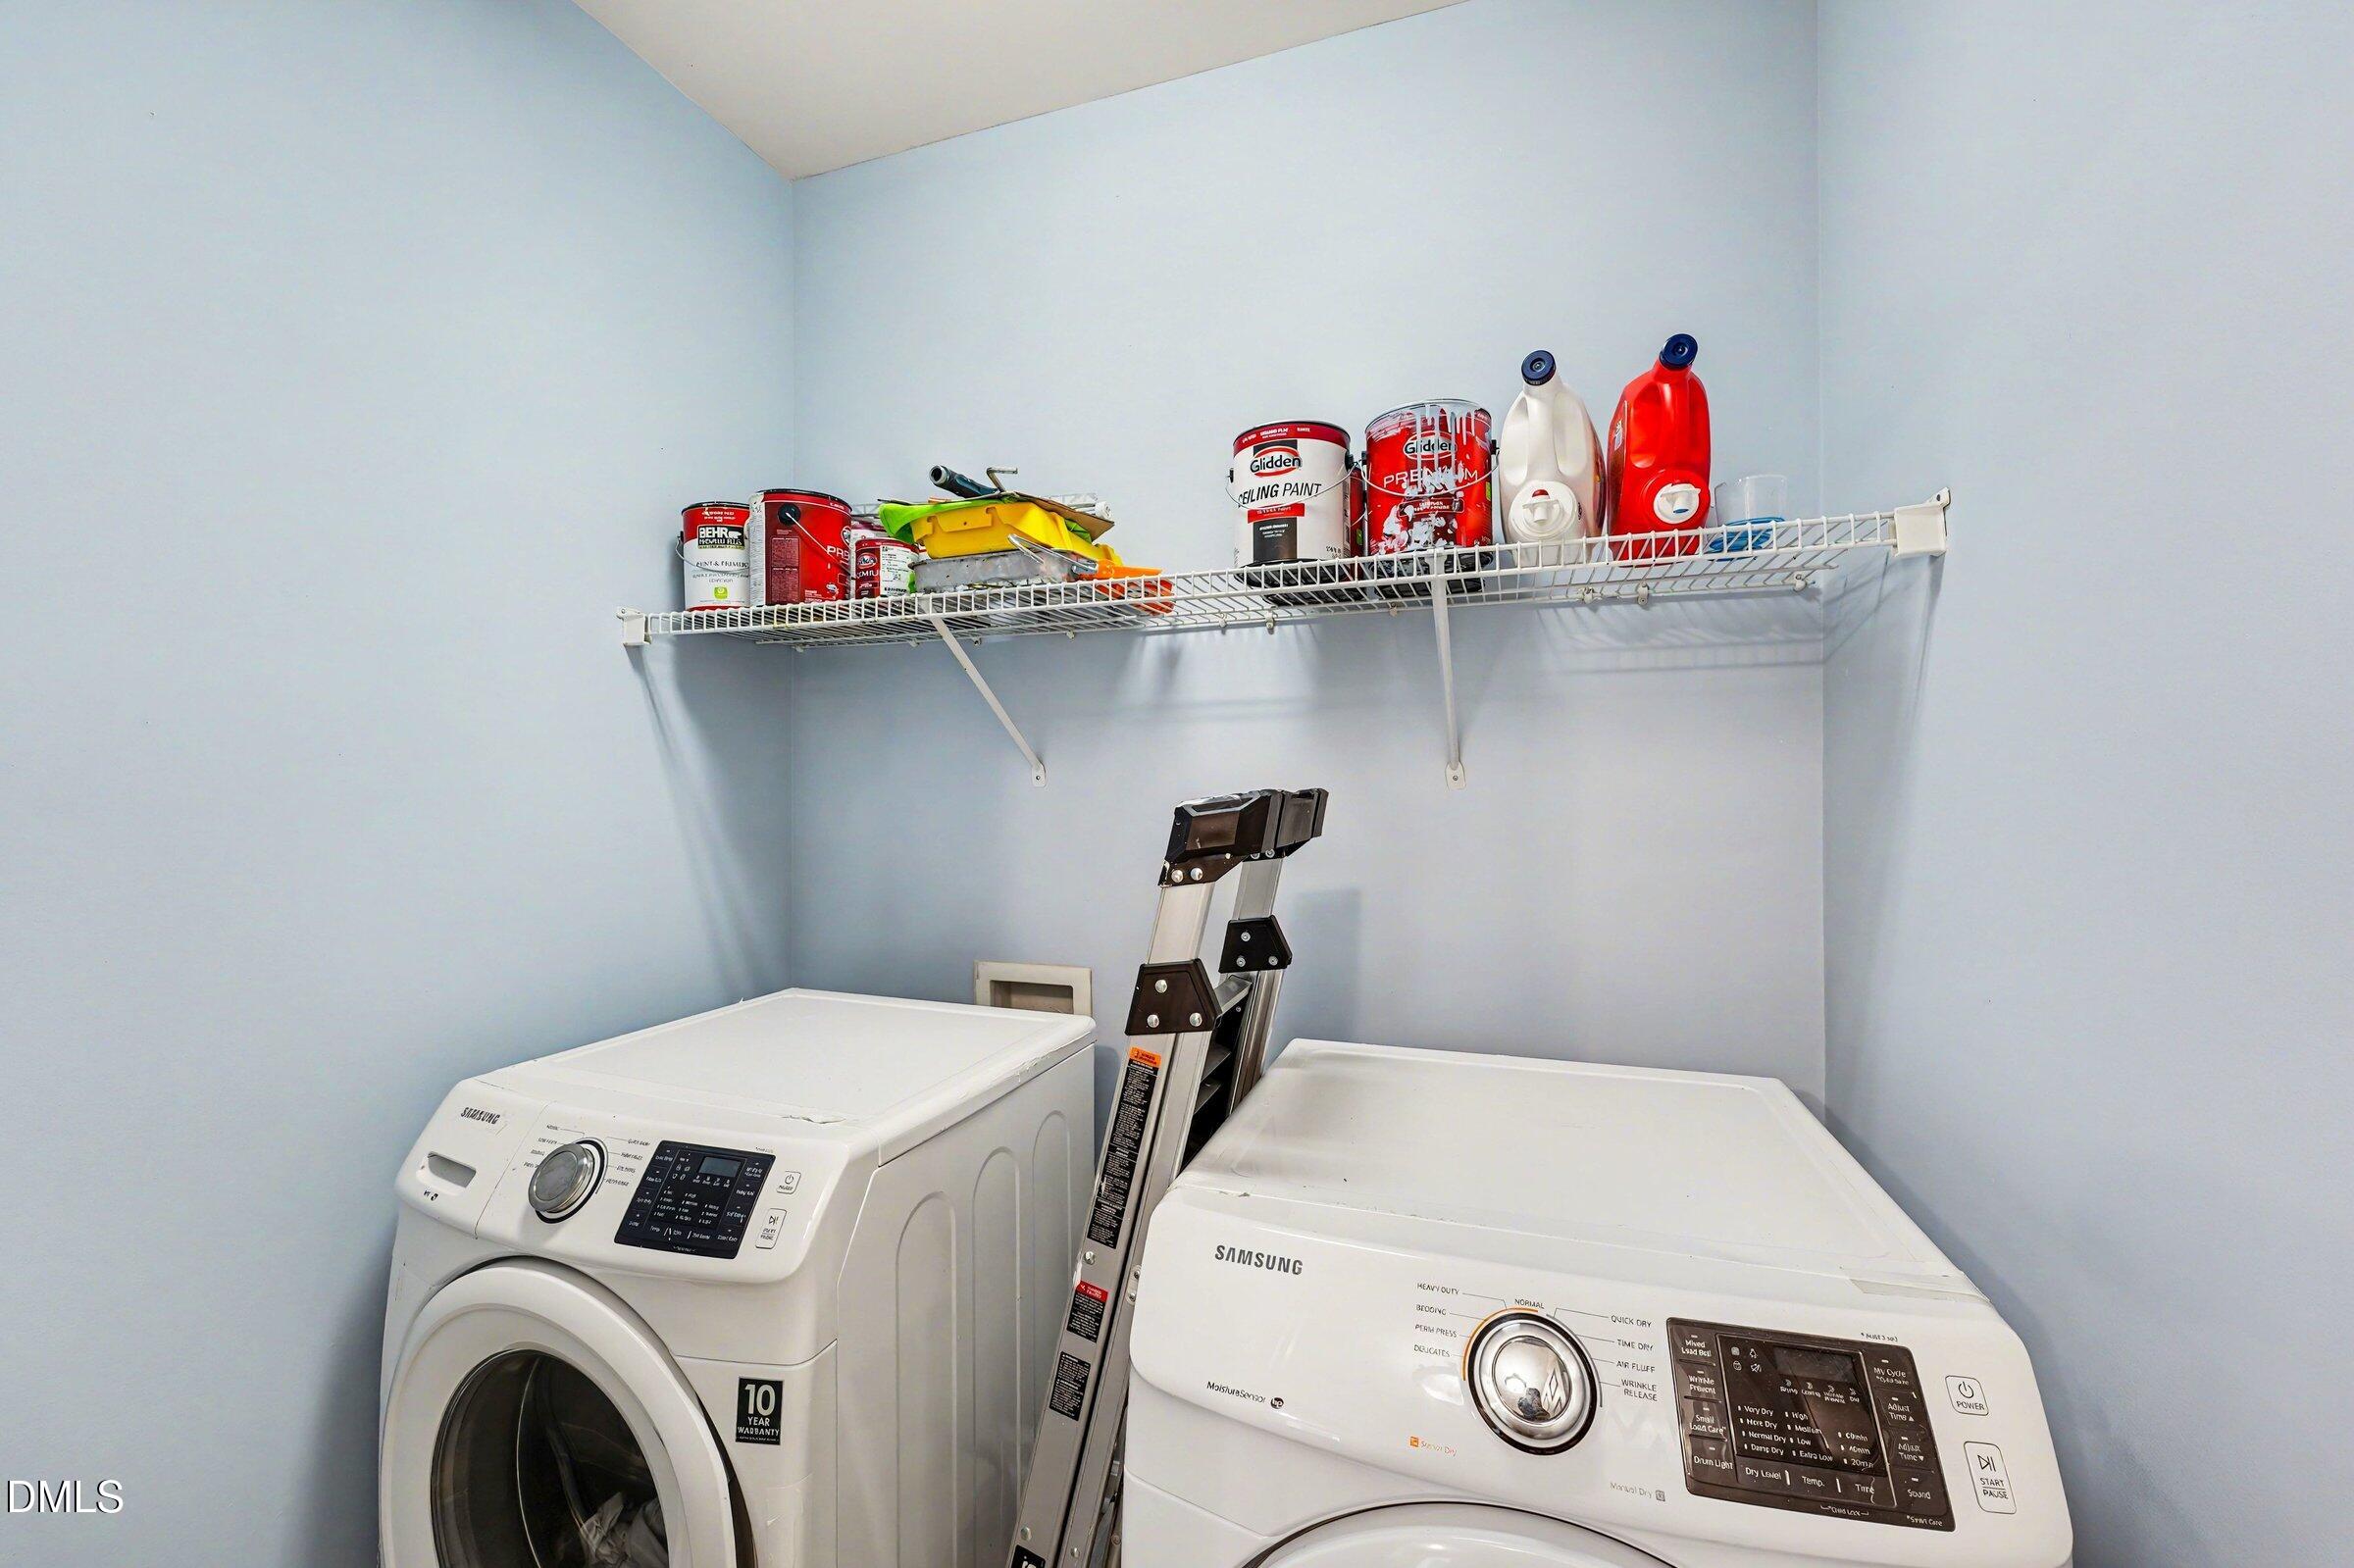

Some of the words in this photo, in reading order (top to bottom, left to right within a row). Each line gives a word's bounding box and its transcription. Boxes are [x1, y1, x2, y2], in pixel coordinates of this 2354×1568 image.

[1251, 455, 1302, 473] Glidden
[1383, 468, 1478, 488] PREM
[1238, 483, 1279, 508] CEILING
[1282, 482, 1322, 497] PAINT
[699, 527, 729, 538] BEHR
[460, 1106, 501, 1125] SAMSUNG
[1214, 1244, 1304, 1276] SAMSUNG
[1416, 1283, 1439, 1292] HEAVY
[1441, 1287, 1460, 1295] DUTY
[1514, 1298, 1545, 1309] NORMAL
[1611, 1314, 1634, 1325] QUICK
[1636, 1319, 1652, 1328] DRY
[1435, 1328, 1458, 1339] PRESS
[1617, 1339, 1636, 1349] TIME
[1616, 1360, 1629, 1369] AIR
[1631, 1362, 1656, 1373] FLUFF
[1621, 1379, 1657, 1391] WRINKLE
[745, 1384, 776, 1416] 10
[1623, 1389, 1658, 1401] RELEASE
[1956, 1400, 1985, 1411] POWER
[1761, 1407, 1774, 1417] Dry
[747, 1416, 770, 1427] YEAR
[1696, 1414, 1714, 1424] Small
[1765, 1421, 1778, 1430] Dry
[737, 1426, 780, 1437] WARRANTY
[1773, 1434, 1787, 1443] Dry
[1797, 1438, 1812, 1446] Low
[1770, 1446, 1784, 1456] Dry
[1694, 1456, 1714, 1466] Drum
[1714, 1458, 1733, 1470] Light
[1745, 1467, 1759, 1478] Dry
[1980, 1478, 2005, 1488] START
[1907, 1489, 1931, 1500] Sound
[1982, 1489, 2009, 1500] PAUSE
